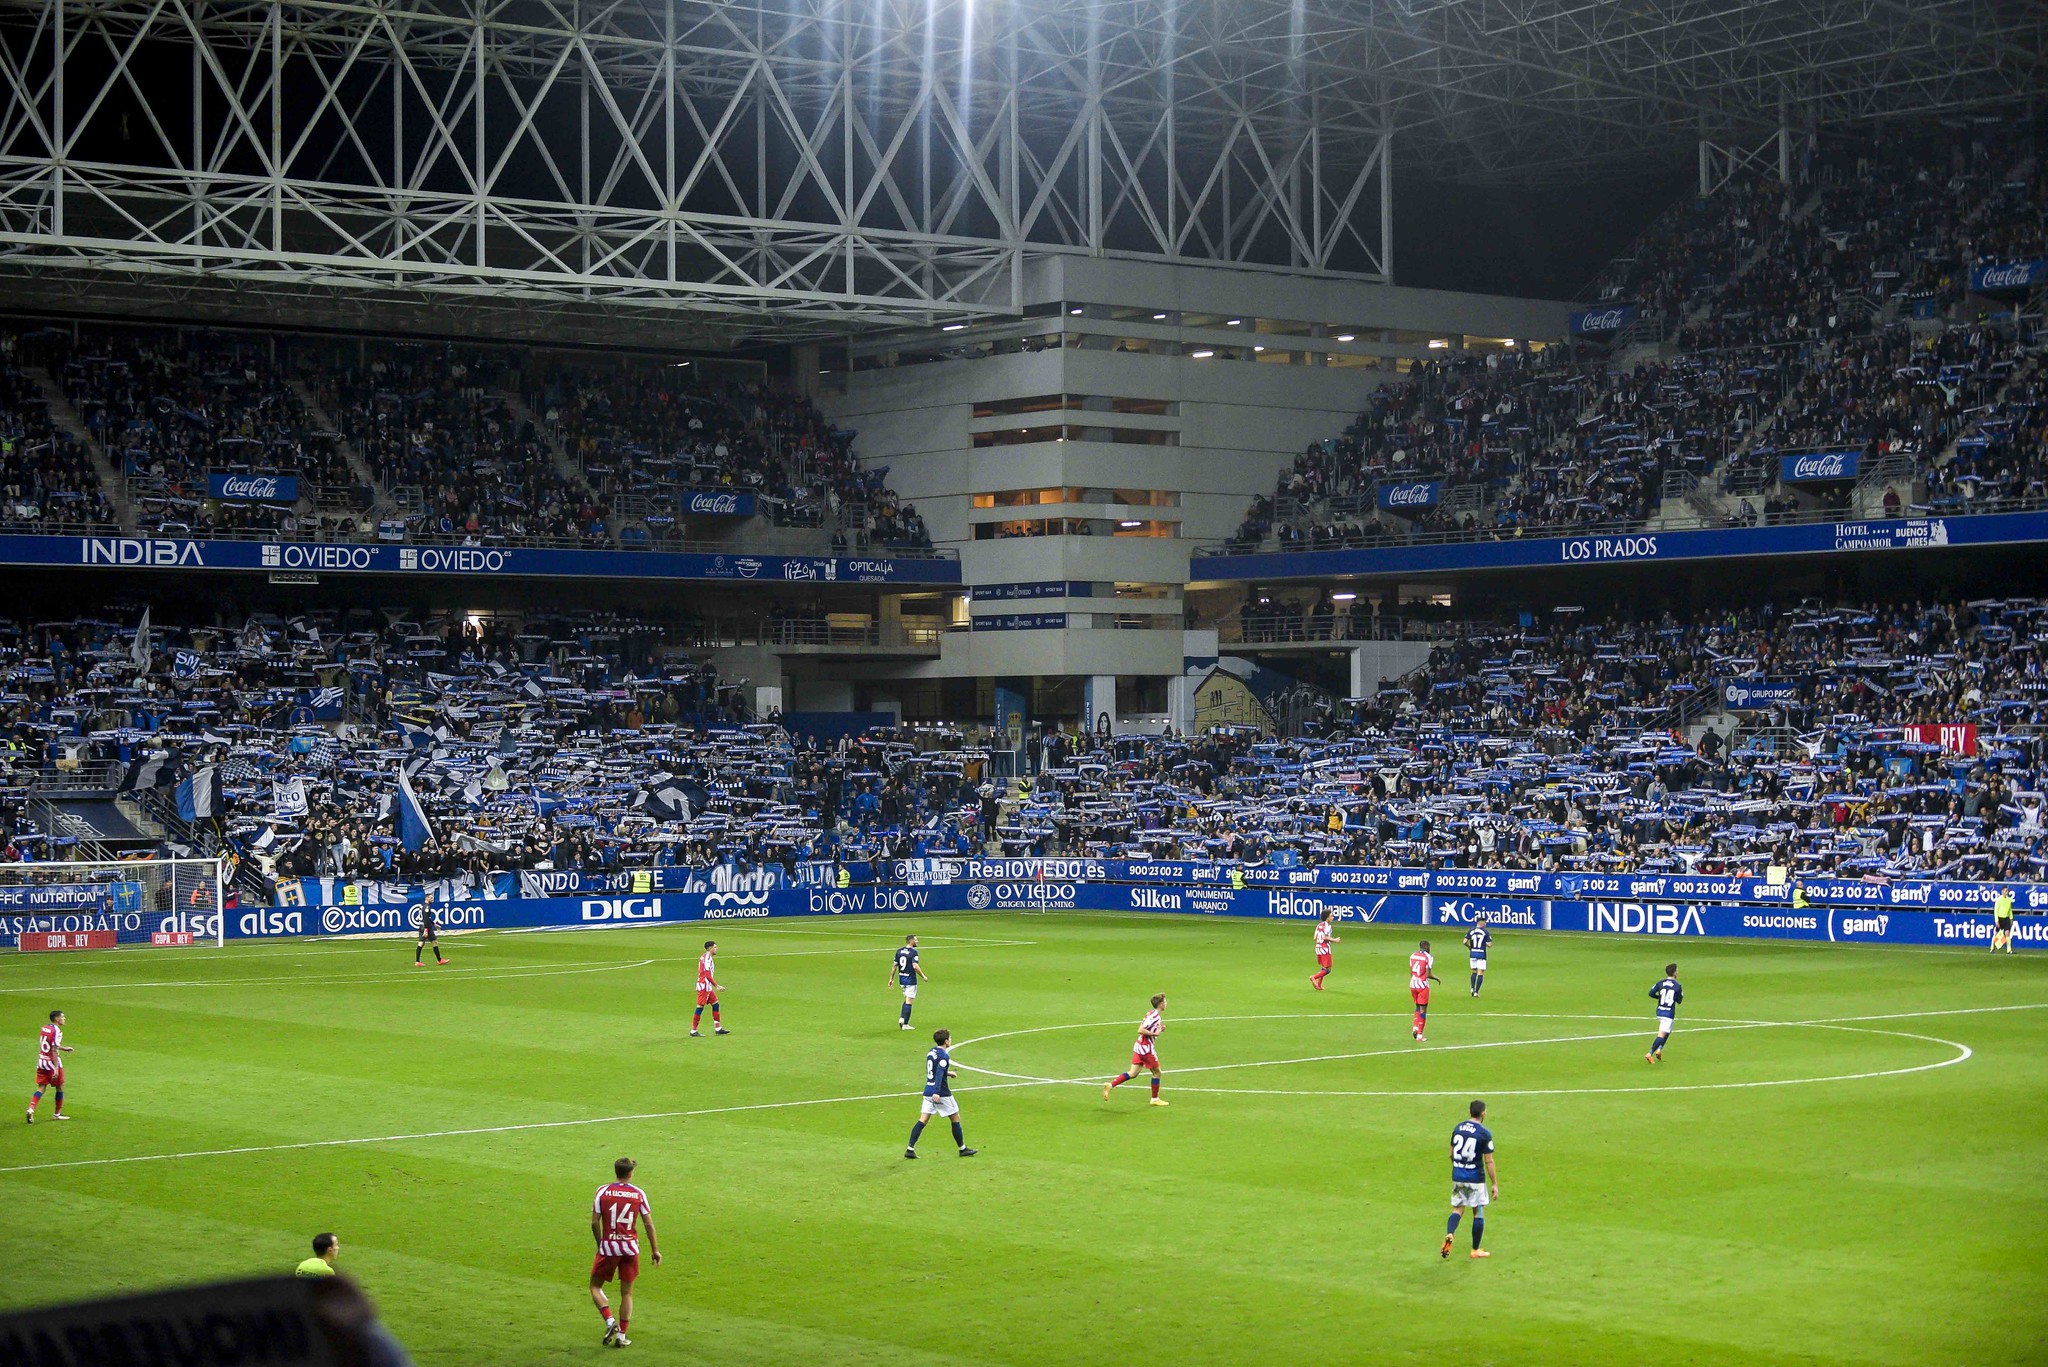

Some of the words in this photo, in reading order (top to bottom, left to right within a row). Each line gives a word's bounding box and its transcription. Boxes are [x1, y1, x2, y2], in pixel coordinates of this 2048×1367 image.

[1896, 527, 1928, 537] BUENOS
[1562, 540, 1590, 560] LOS
[1595, 537, 1657, 558] PRADOS
[1906, 538, 1928, 547] AIRES
[176, 651, 200, 670] SM
[1752, 689, 1773, 698] GRUPO
[530, 872, 580, 892] ONDO
[606, 870, 664, 890] NOE
[907, 871, 951, 881] CARBAYONES
[1129, 866, 1148, 876] 900
[1149, 866, 1158, 876] 23
[1160, 867, 1170, 876] 00
[1171, 867, 1183, 877] 22
[1245, 870, 1254, 879] 23
[1255, 870, 1267, 879] 00
[1269, 870, 1279, 880] 22
[1331, 872, 1348, 882] 900
[1350, 873, 1361, 883] 23
[1362, 873, 1374, 884] 00
[1375, 873, 1387, 884] 22
[1436, 875, 1455, 886] 900
[1457, 876, 1468, 887] 23
[1470, 876, 1482, 887] 00
[1484, 876, 1496, 887] 22
[1591, 880, 1604, 890] 00
[1606, 880, 1619, 890] 22
[1673, 881, 1693, 893] 900
[1695, 881, 1708, 893] 23
[1710, 882, 1724, 894] 00
[1728, 883, 1741, 895] 22
[1830, 886, 1843, 898] 23
[1846, 887, 1861, 898] 00
[1864, 887, 1877, 898] 22
[1939, 888, 1963, 901] 900
[1965, 889, 1979, 902] 23
[1982, 890, 1997, 902] 00
[995, 884, 1076, 899] OVIEDO
[1130, 887, 1181, 910] Silken
[1185, 889, 1235, 900] MONUMENTAL
[582, 898, 661, 921] DIGI
[1192, 901, 1228, 911] NARANCO
[1268, 891, 1323, 916] Halcon
[50, 913, 141, 933] LOBATO
[239, 908, 302, 934] alsa
[1461, 902, 1536, 925] CaixaBank
[1743, 915, 1817, 929] SOLUCIONES
[1934, 918, 1996, 940] Tartier
[48, 935, 66, 948] COPA
[76, 934, 88, 947] REY
[155, 934, 170, 945] COPA
[177, 934, 188, 945] REY
[1471, 934, 1485, 948] 17
[900, 956, 907, 971] 9
[1412, 961, 1420, 976] 4
[1660, 988, 1675, 1007] 14
[927, 1059, 934, 1080] 8
[1453, 1134, 1477, 1162] 24
[609, 1201, 634, 1231] 14
